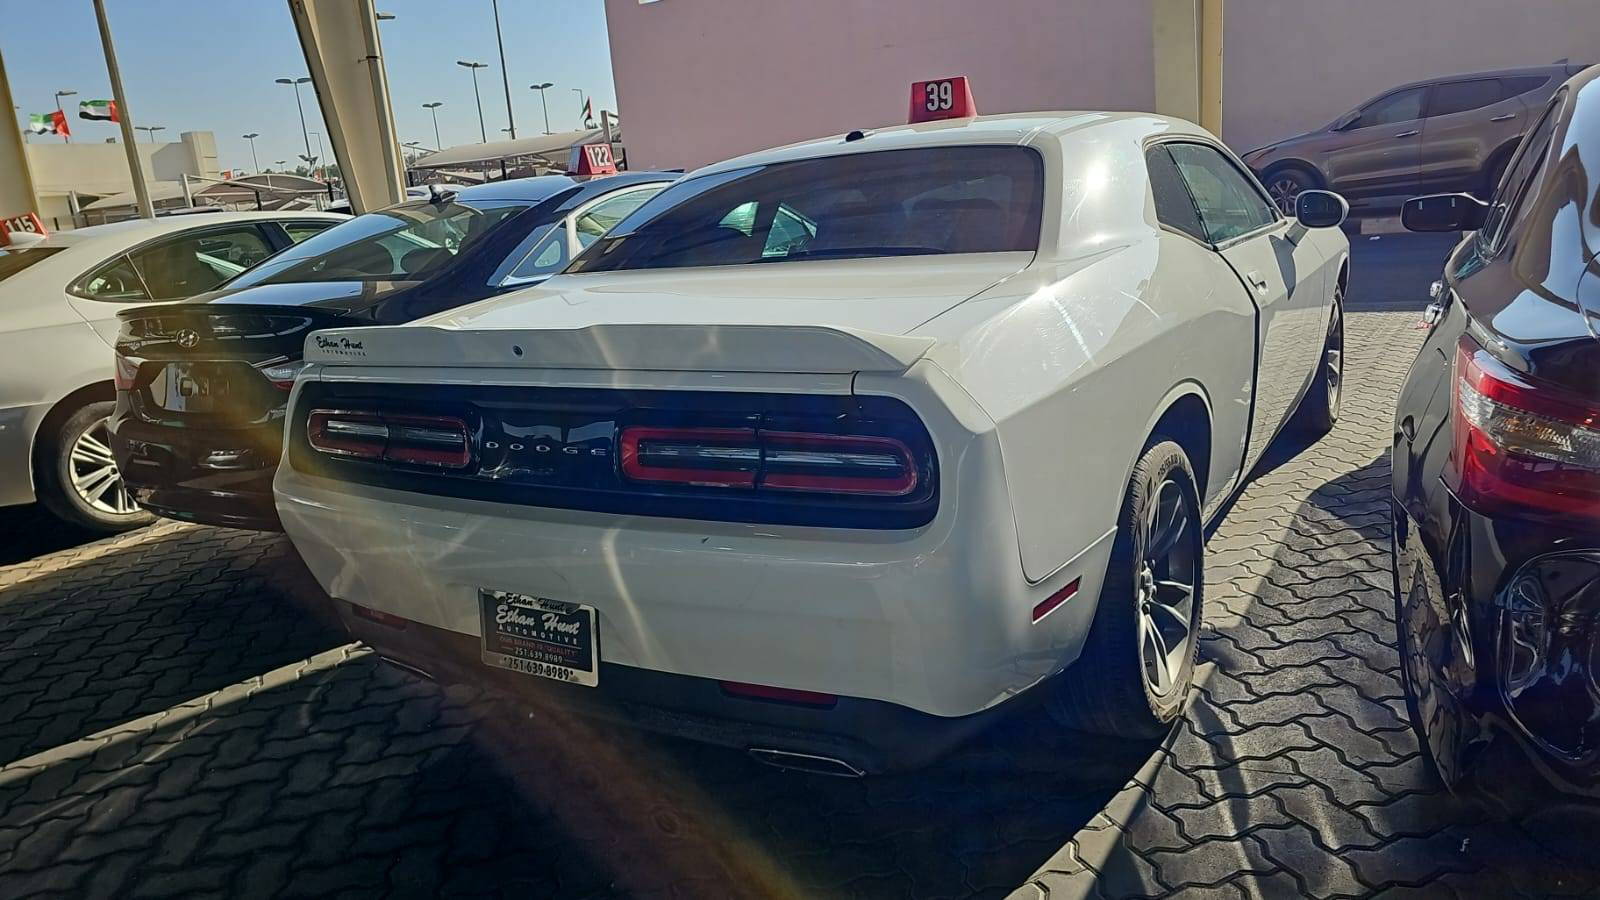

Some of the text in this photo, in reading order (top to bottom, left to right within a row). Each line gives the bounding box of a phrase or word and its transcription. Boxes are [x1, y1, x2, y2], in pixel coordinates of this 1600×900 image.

[926, 81, 953, 111] 39
[588, 146, 612, 167] 122
[5, 215, 36, 233] 115
[485, 441, 607, 456] DODGE
[495, 604, 580, 635] Ethan Hunt
[499, 623, 577, 645] AUTOMOTIVE
